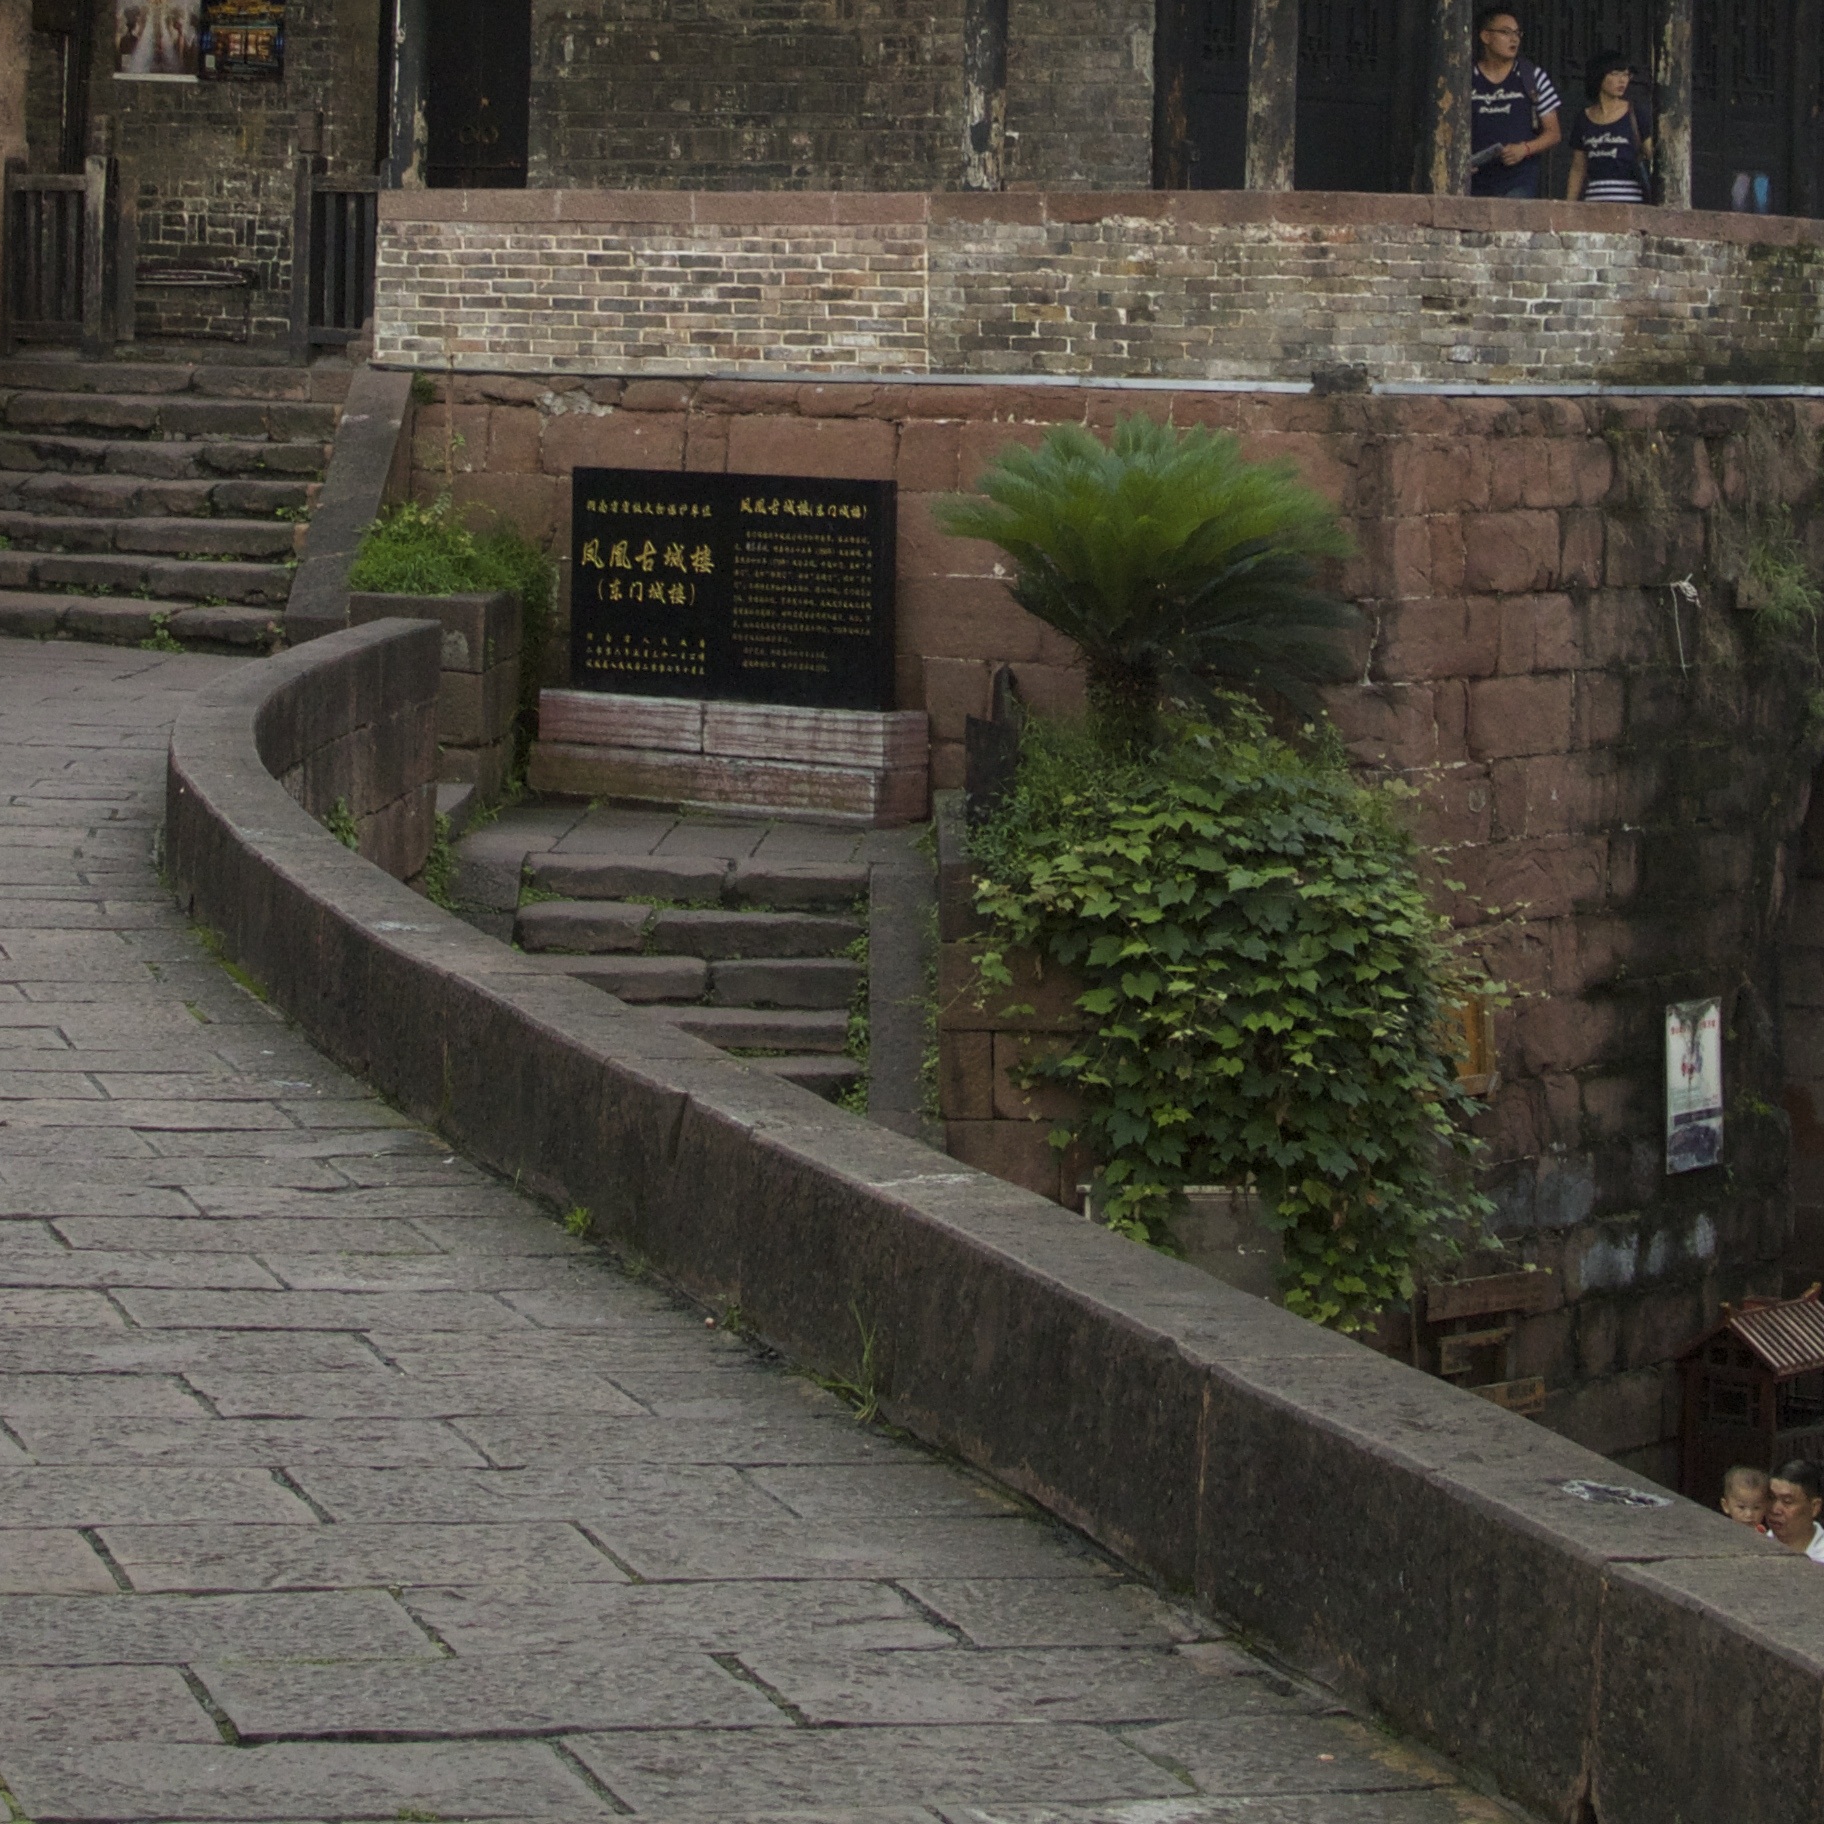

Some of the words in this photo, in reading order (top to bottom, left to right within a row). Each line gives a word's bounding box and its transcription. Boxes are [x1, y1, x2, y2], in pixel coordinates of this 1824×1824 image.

[580, 536, 716, 575] 凤凰古城楼
[597, 577, 696, 606] (东门城楼)
